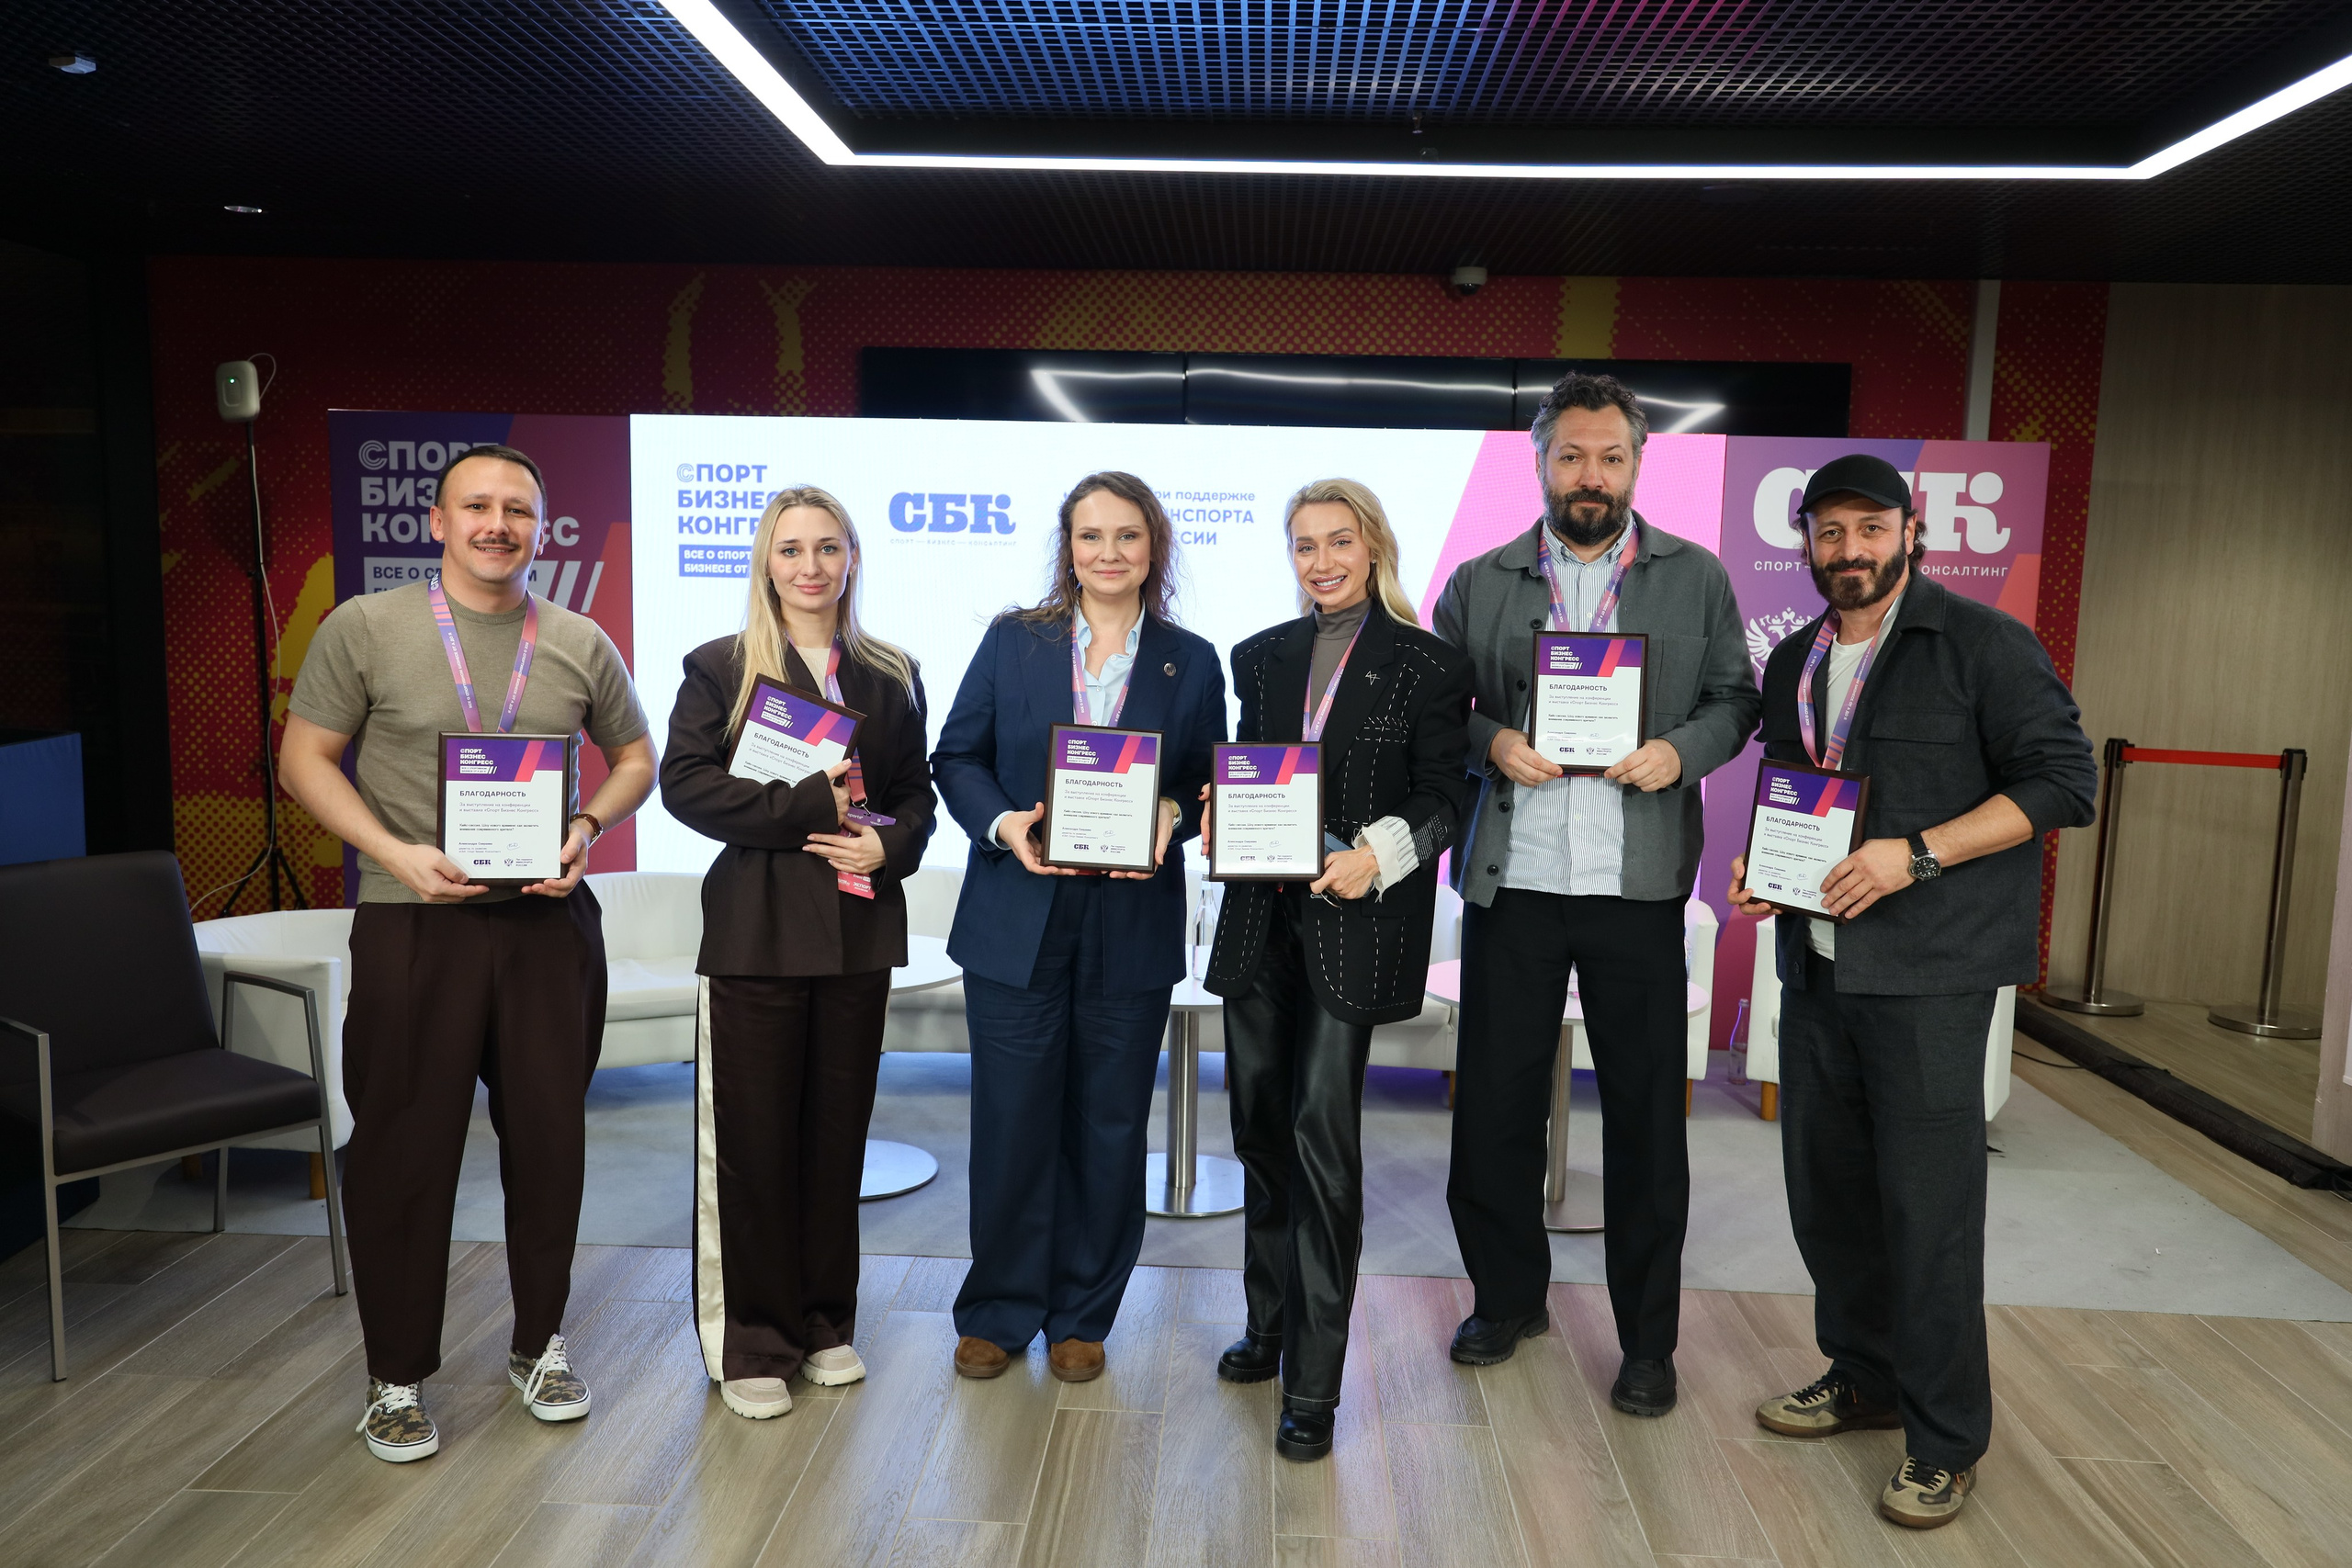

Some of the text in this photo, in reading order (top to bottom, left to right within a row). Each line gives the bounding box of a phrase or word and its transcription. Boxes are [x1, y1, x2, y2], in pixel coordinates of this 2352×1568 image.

[677, 463, 767, 483] СПОРТ
[361, 477, 438, 507] БИЗ
[1176, 491, 1255, 502] поддержке
[888, 491, 1016, 535] СБК
[1170, 508, 1254, 524] НСПОРТА
[678, 515, 761, 536] КОНГР
[684, 549, 752, 560] ВСЕ О СПОРТ
[373, 567, 403, 579] ВСЕ
[408, 567, 420, 580] О
[684, 563, 748, 574] БИЗНЕСЕ ОТ
[1754, 560, 2008, 577] СПОРТ ОНСАЛТИНГ
[764, 700, 788, 713] БИЗНЕС
[766, 695, 786, 707] СПОРТ
[763, 705, 793, 720] КОНГРЕСС
[753, 732, 810, 759] БЛАГОДАРНОСТЬ
[1065, 779, 1123, 788] БЛАГОДАРНОСТЬ
[1770, 782, 1792, 790] БИЗНЕС
[1771, 776, 1791, 784] СПОРТ
[1770, 787, 1798, 796] КОНГРЕСС
[1766, 816, 1821, 832] БЛАГОДАРНОСТЬ
[1768, 882, 1782, 891] СБК
